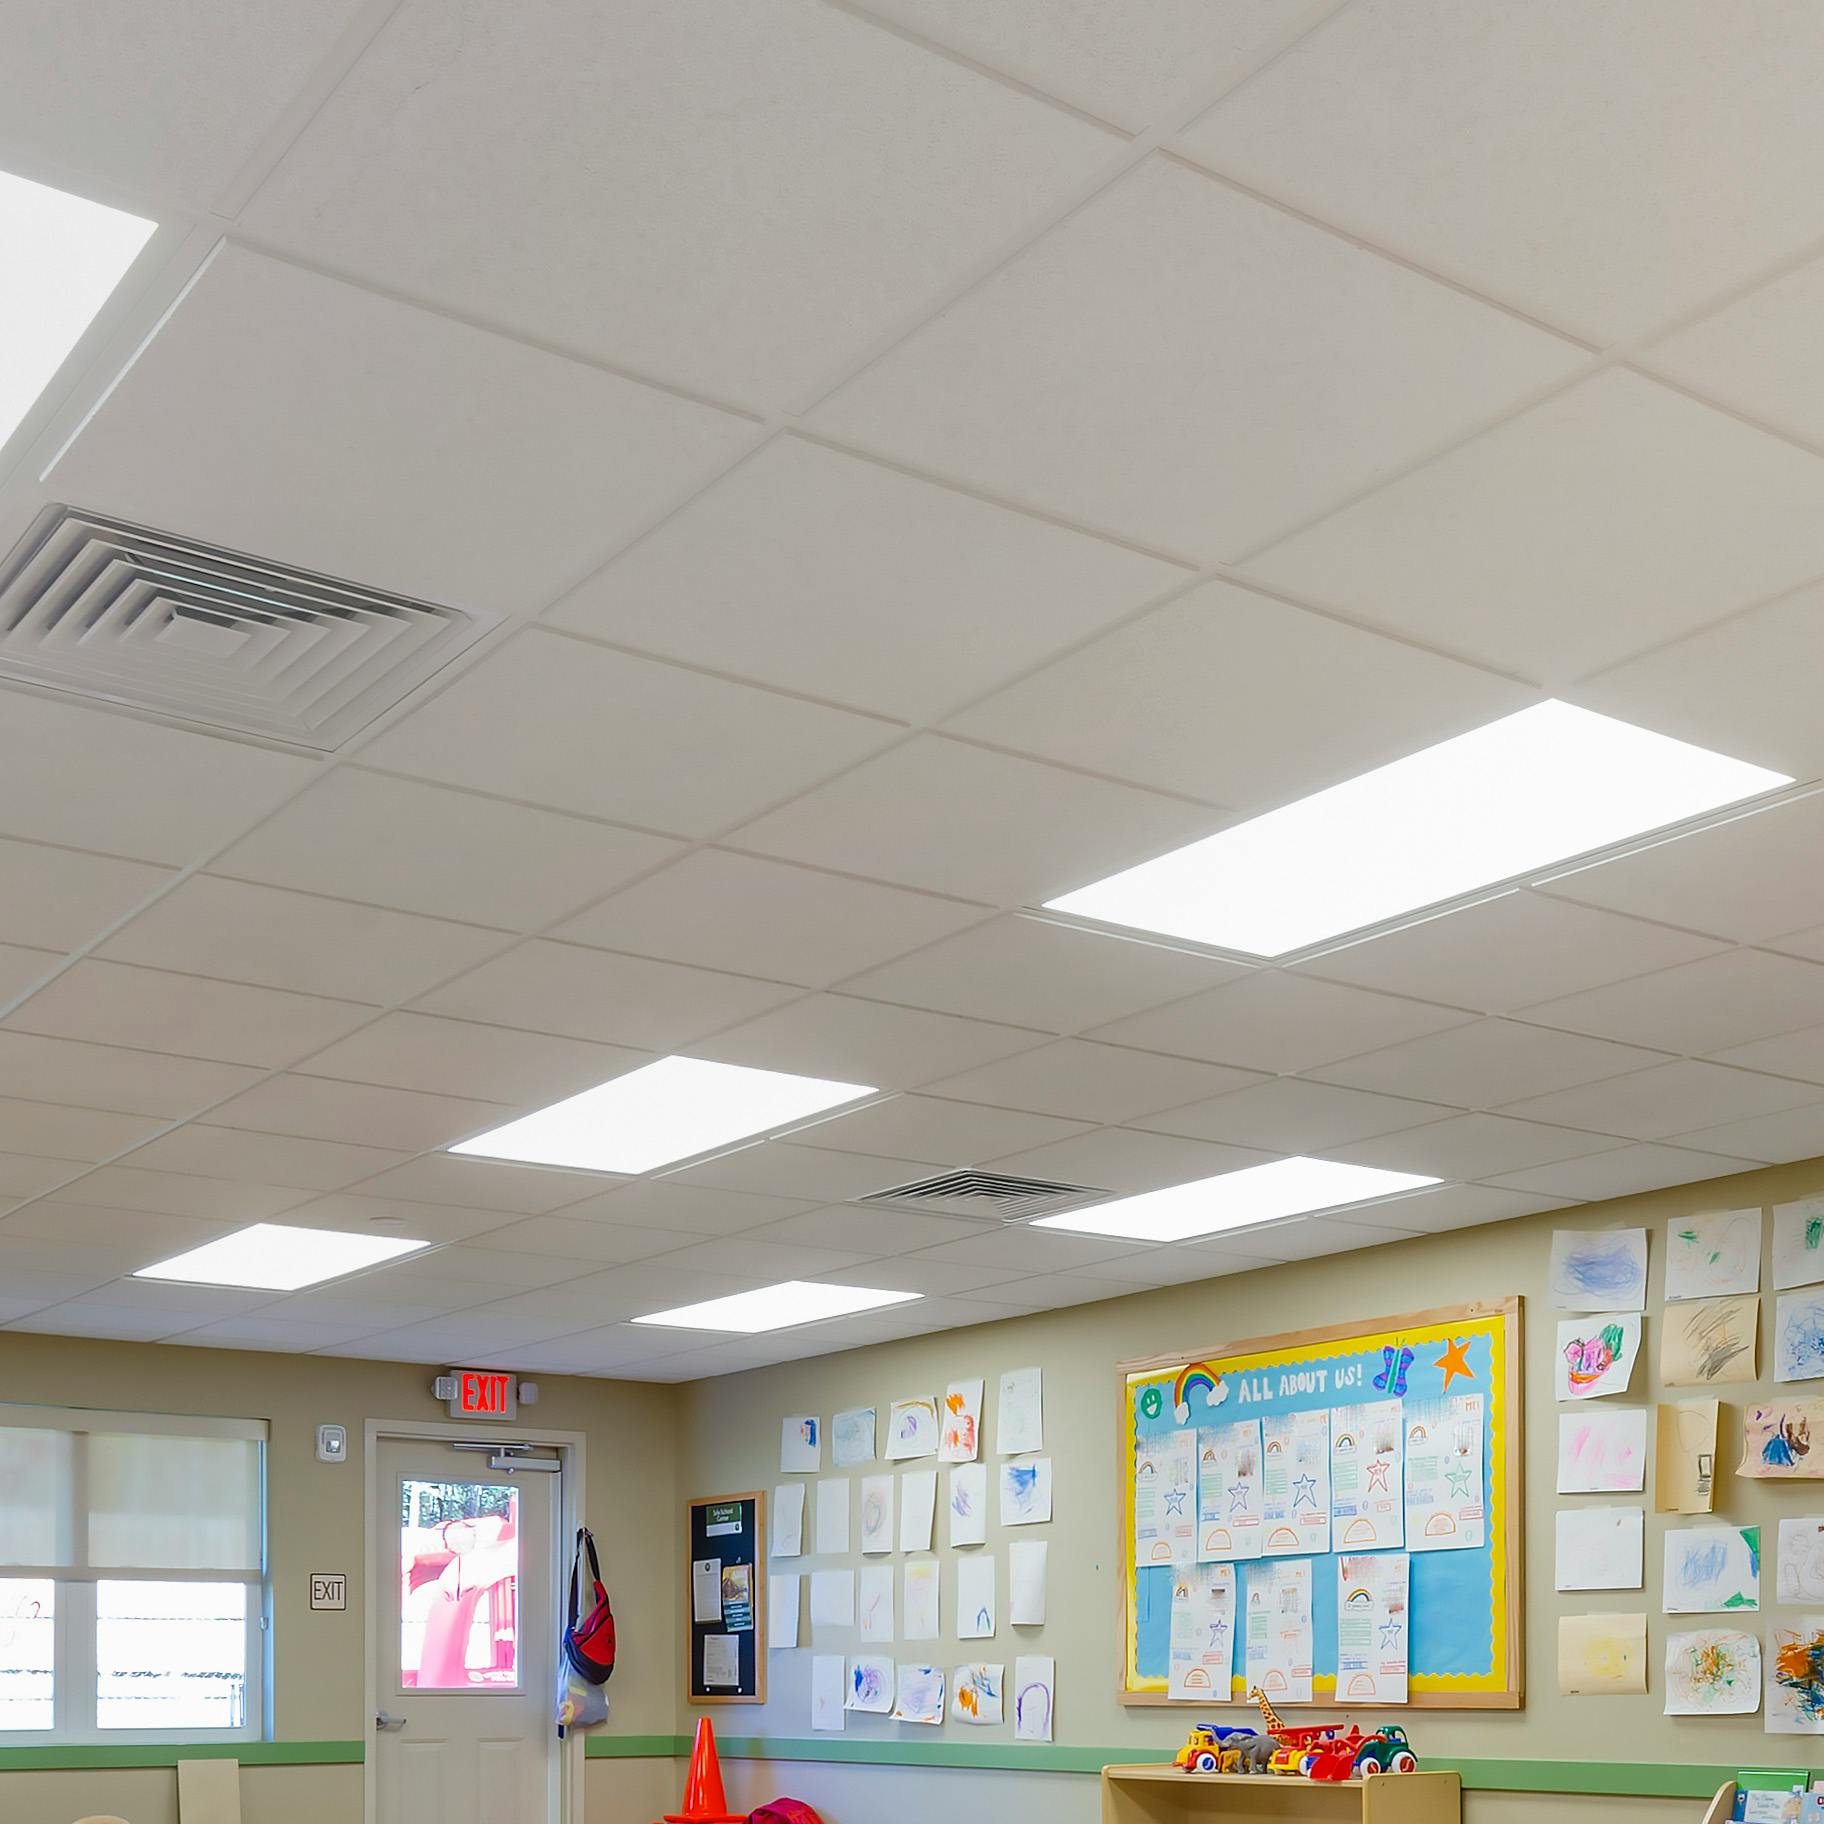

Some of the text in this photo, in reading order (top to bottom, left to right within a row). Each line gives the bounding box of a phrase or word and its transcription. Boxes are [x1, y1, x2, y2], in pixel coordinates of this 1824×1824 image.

[461, 1372, 510, 1414] EXIT
[1238, 1363, 1363, 1404] ALL ABOUT US!
[314, 1580, 343, 1601] EXIT
